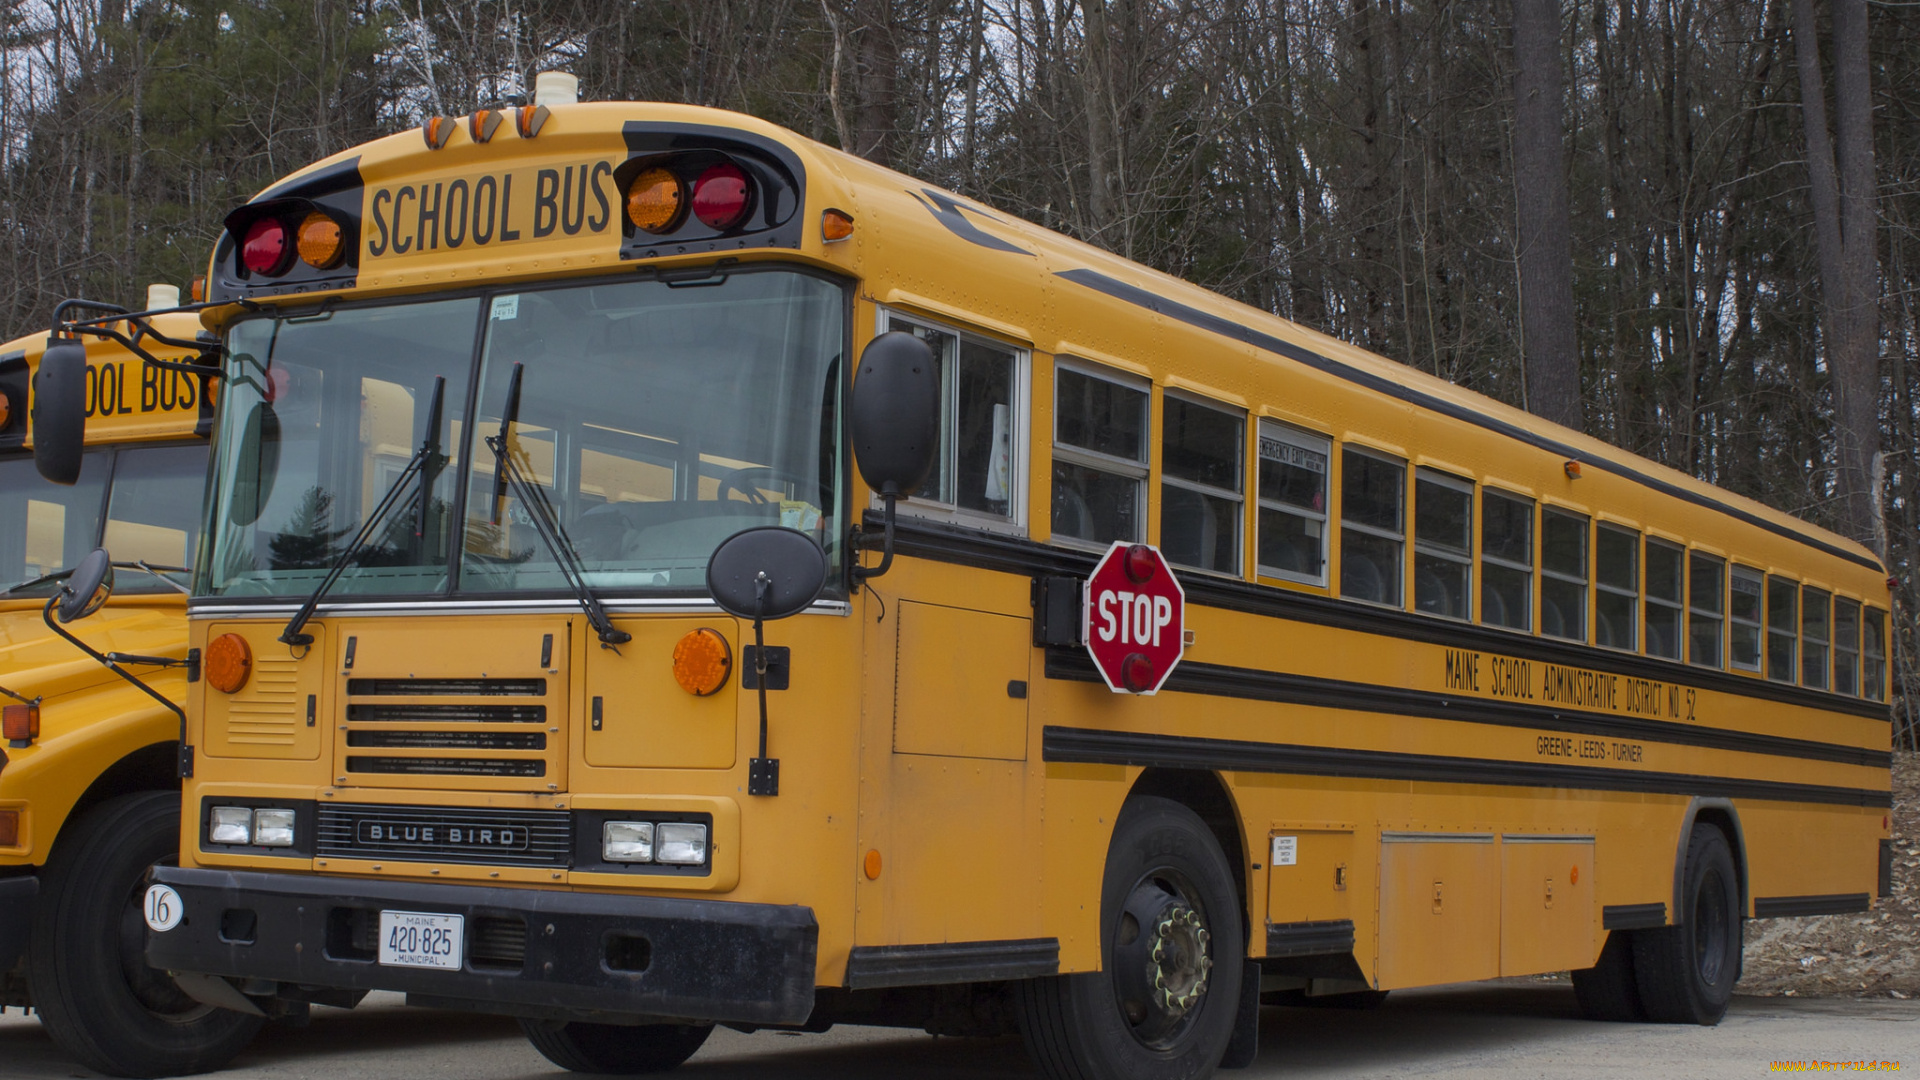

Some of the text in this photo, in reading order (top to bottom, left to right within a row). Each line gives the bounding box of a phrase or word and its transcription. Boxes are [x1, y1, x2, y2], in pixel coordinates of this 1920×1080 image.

[368, 160, 612, 257] SCHOOL BUS
[141, 355, 198, 412] BUS
[1098, 589, 1172, 647] STOP
[1445, 649, 1480, 692] MAINE
[1492, 656, 1534, 699] SCHOOL
[1543, 664, 1617, 710] ADMINISTRATIVE
[1626, 678, 1662, 715] DISTRICT
[1686, 688, 1696, 721] 52
[1537, 735, 1572, 757] GREENE
[1579, 740, 1606, 759] LEEDS
[1612, 743, 1643, 763] TURNER
[370, 825, 514, 845] BLUE BIRD
[150, 890, 172, 925] 16
[406, 917, 436, 926] MAINE
[398, 954, 440, 966] MUNICIPAL
